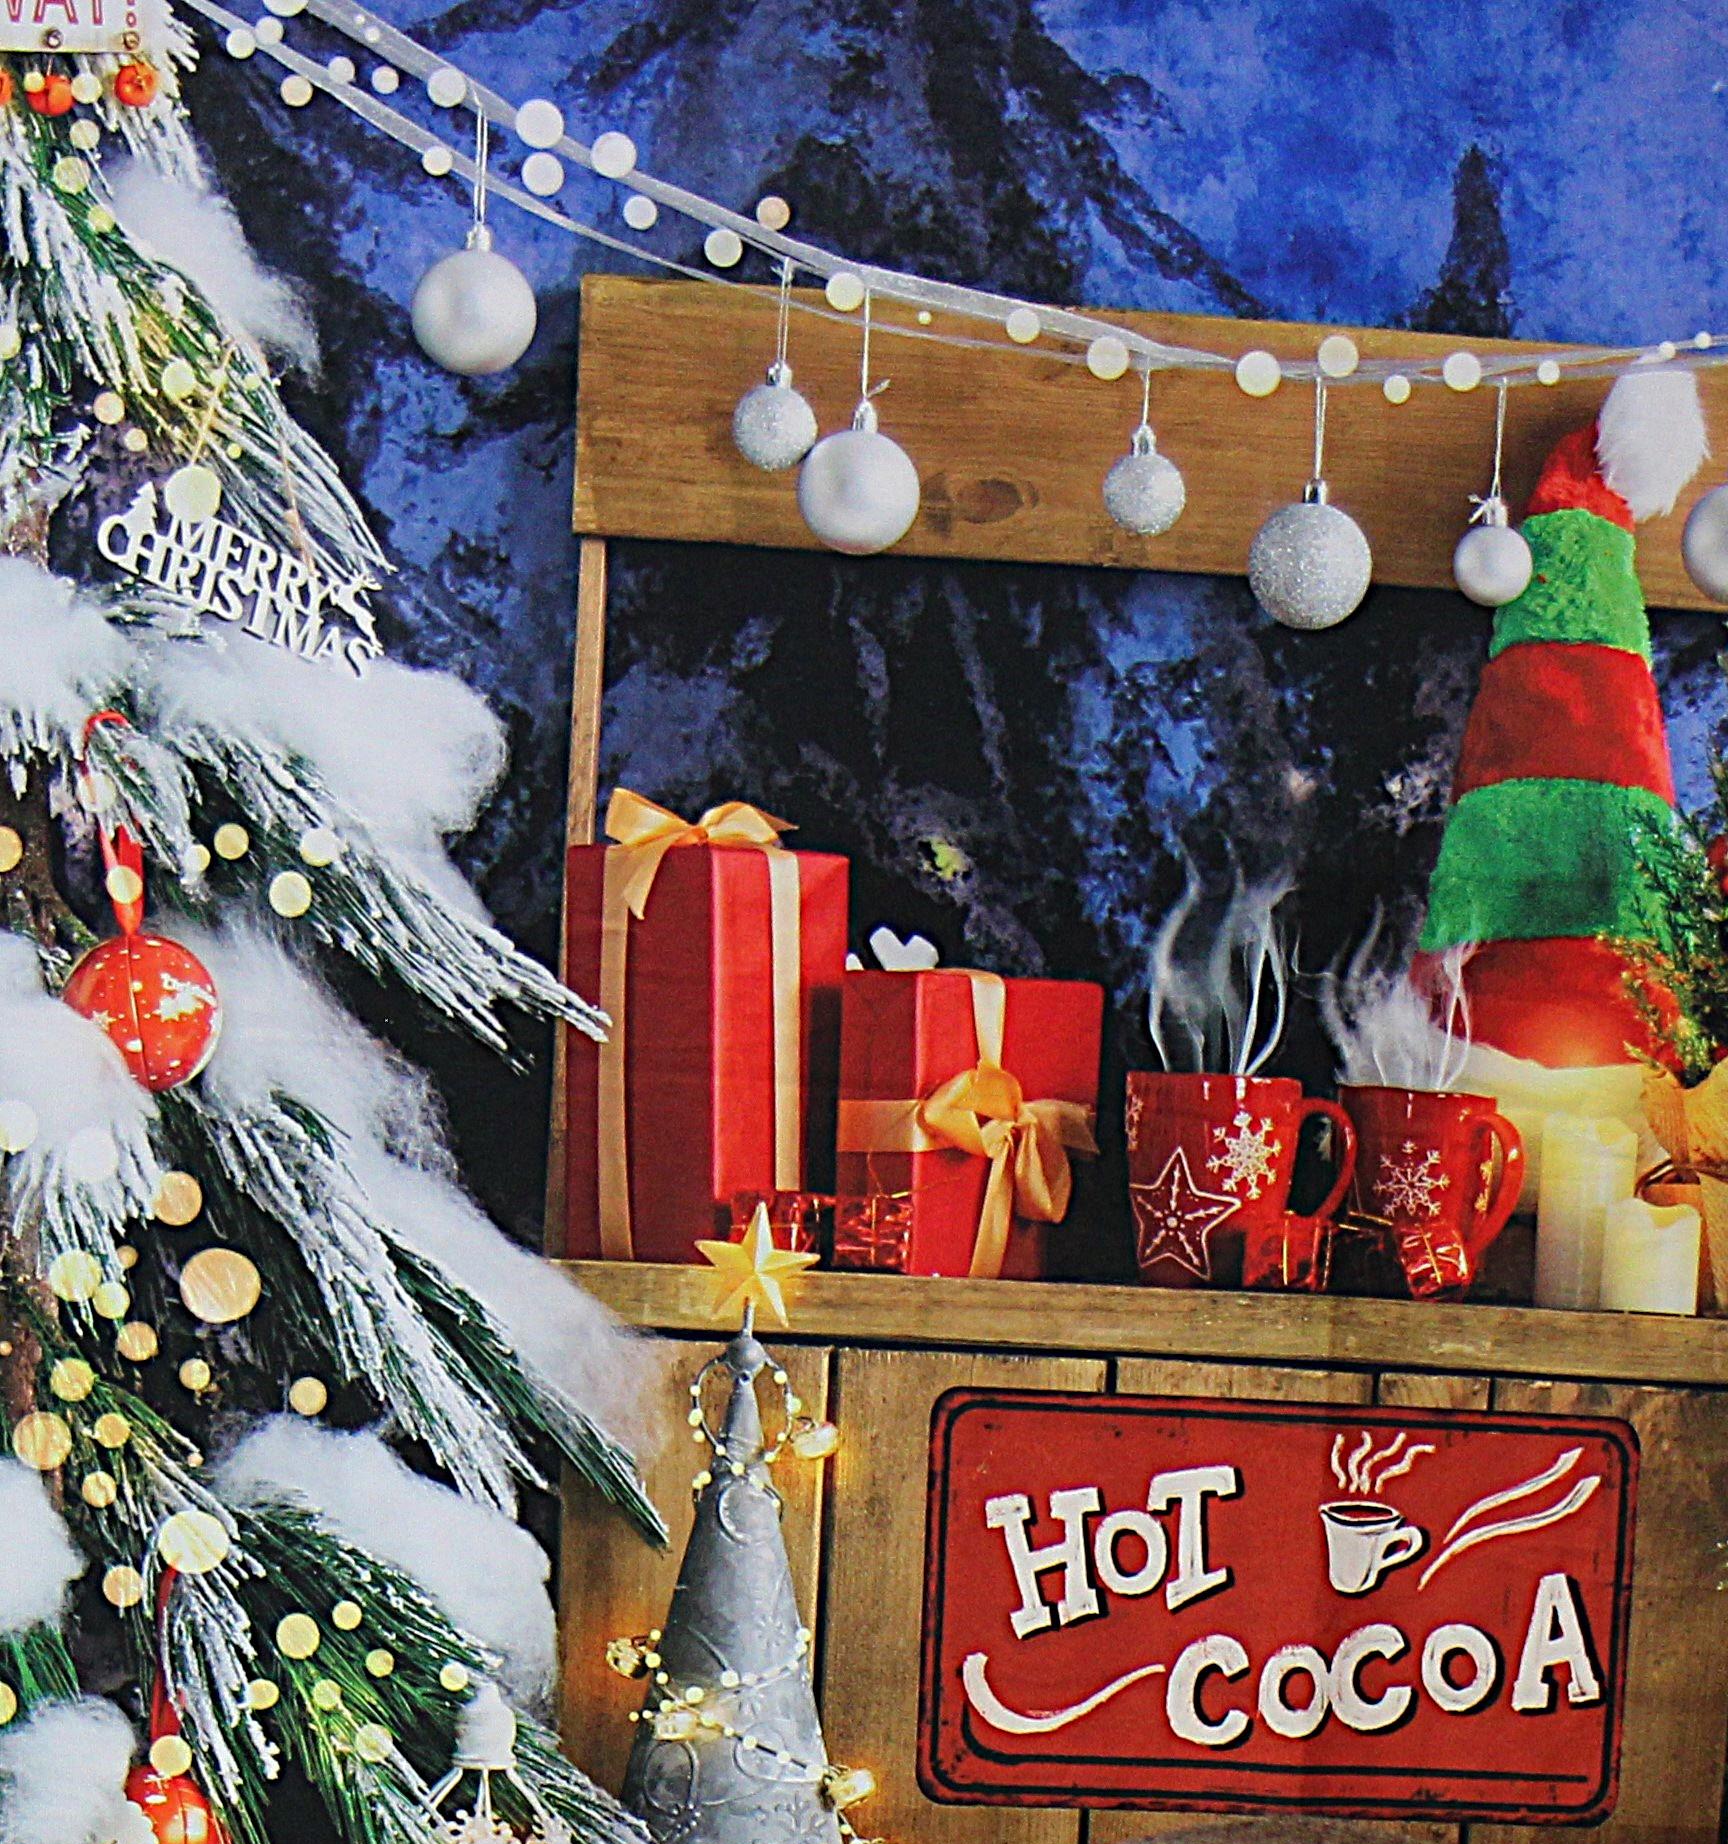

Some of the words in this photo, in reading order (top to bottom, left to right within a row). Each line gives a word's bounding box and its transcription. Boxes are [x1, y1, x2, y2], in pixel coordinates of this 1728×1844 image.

[97, 514, 378, 679] CHRISTMAS
[163, 512, 338, 617] MERRY
[985, 1464, 1241, 1641] HOT
[1165, 1571, 1604, 1748] COCOA
